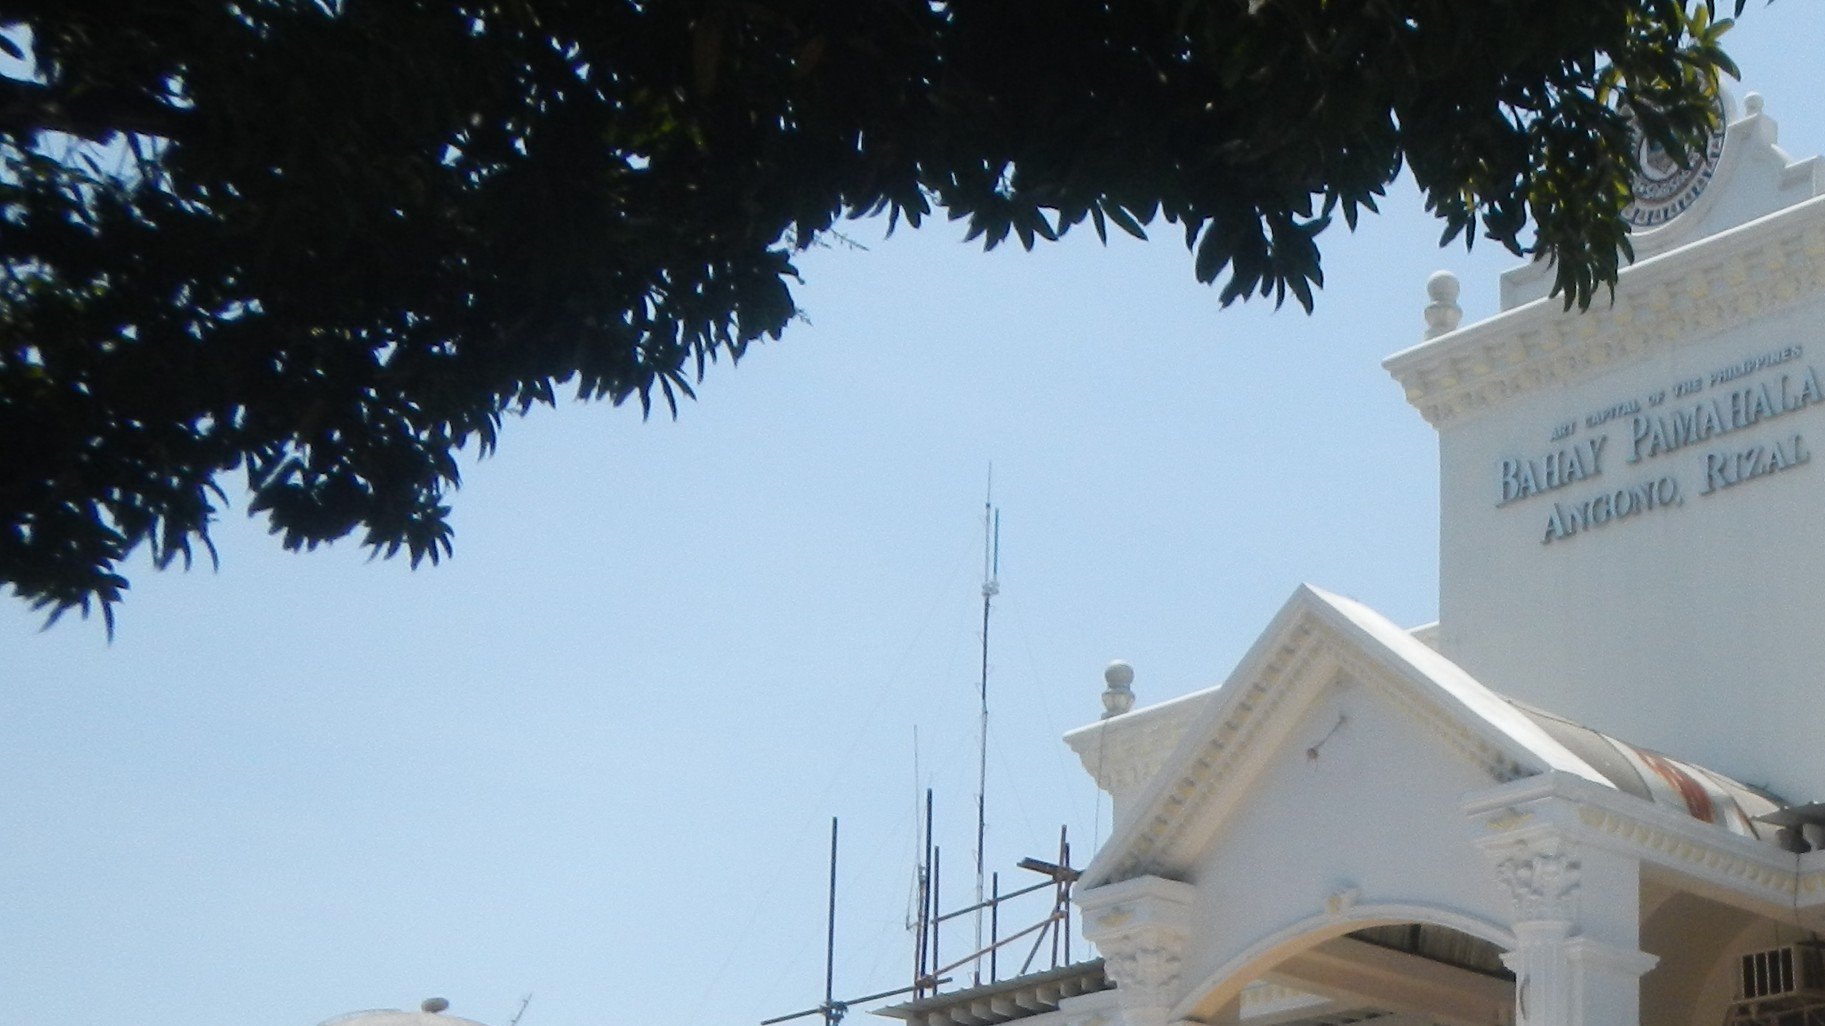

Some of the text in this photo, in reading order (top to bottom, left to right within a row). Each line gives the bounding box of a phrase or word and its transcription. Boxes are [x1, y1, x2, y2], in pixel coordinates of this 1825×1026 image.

[1550, 345, 1803, 442] ART CAPITAL OF THE PHILIPPINES
[1497, 434, 1608, 508] BAHAY
[1540, 434, 1812, 545] ANGONO, RIZAL
